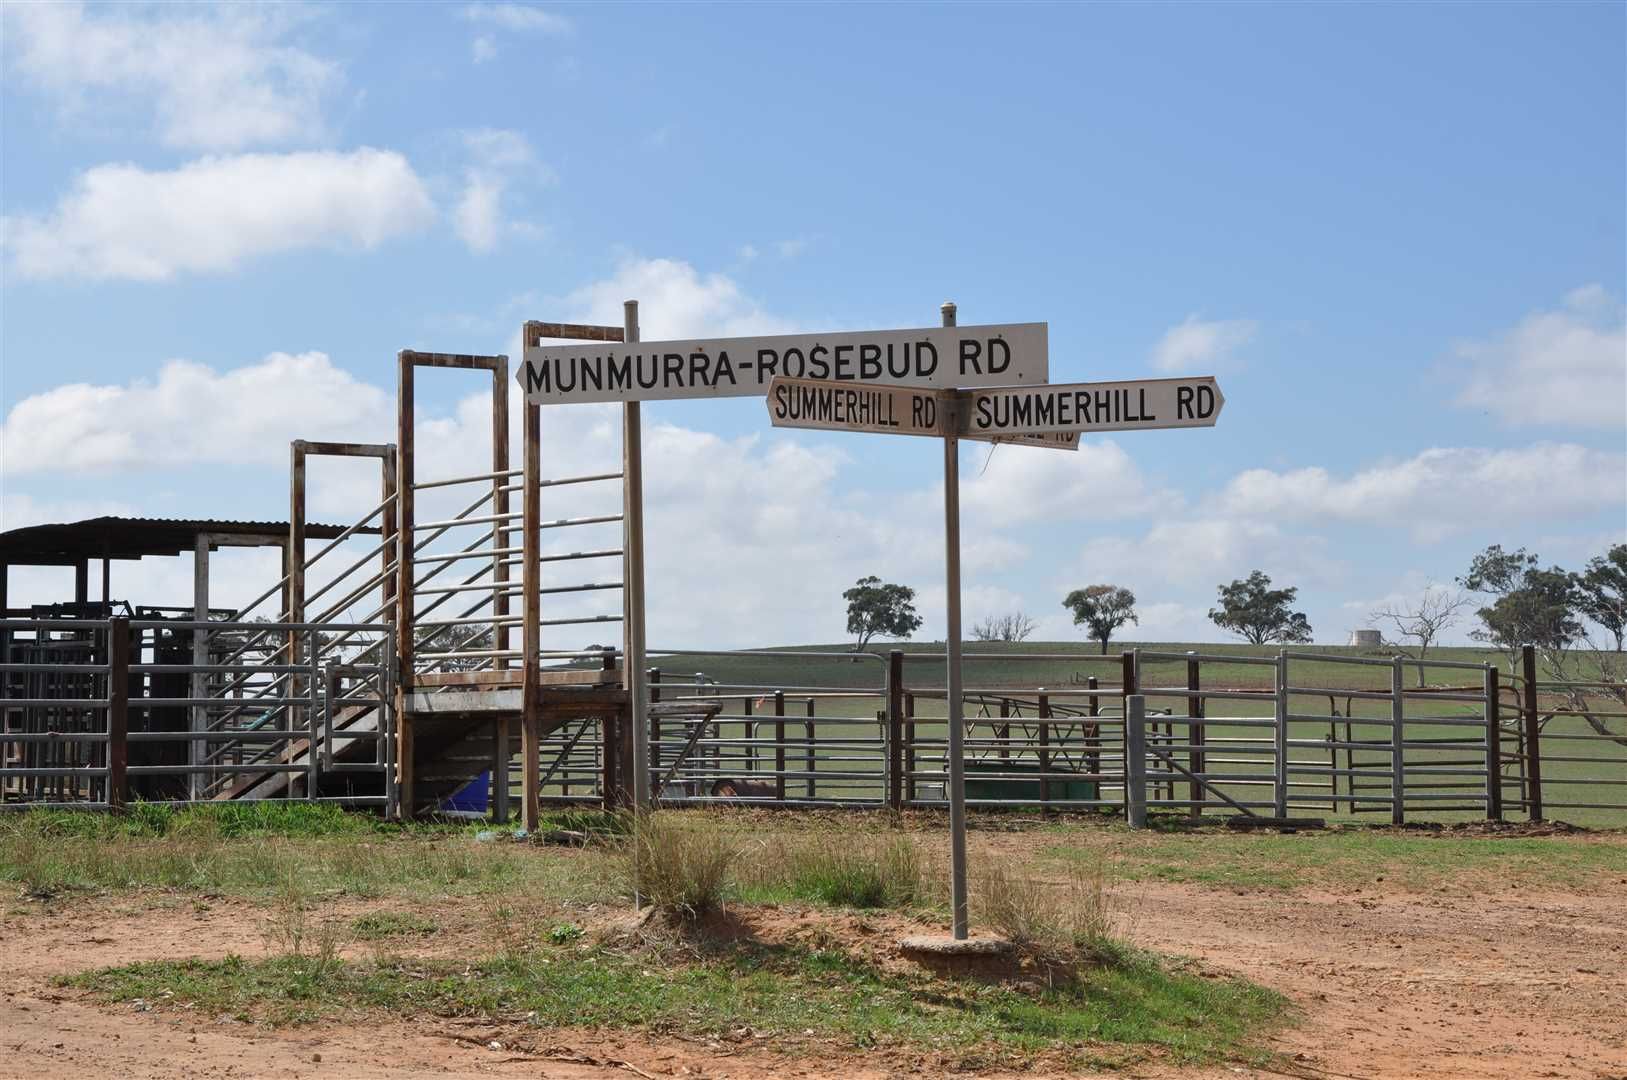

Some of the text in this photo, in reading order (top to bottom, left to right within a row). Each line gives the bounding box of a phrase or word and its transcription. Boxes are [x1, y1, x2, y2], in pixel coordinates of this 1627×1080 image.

[526, 338, 1011, 394] MUNMURRA-ROSEBUD RD
[775, 385, 936, 429] SUMMERHILL RD
[976, 385, 1215, 429] SUMMERHILL RD
